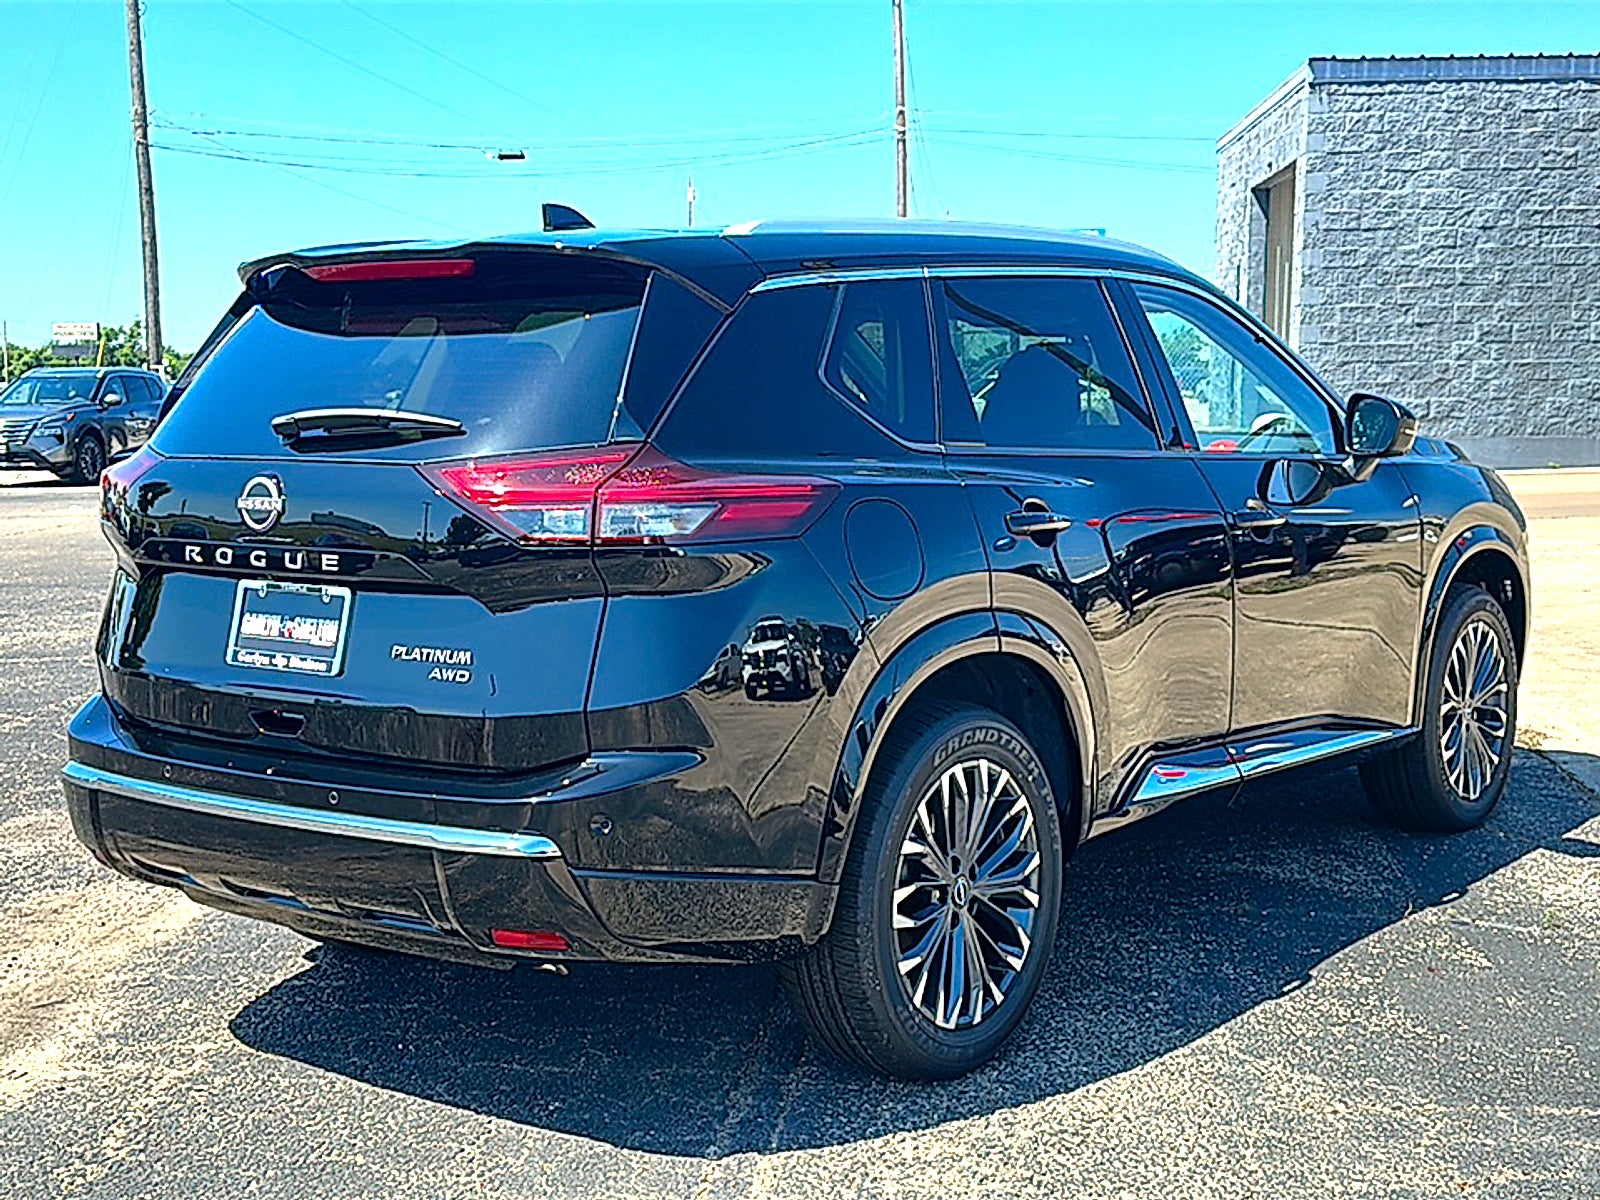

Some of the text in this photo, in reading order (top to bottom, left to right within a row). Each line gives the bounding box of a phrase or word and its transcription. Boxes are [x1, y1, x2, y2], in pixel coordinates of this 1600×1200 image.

[238, 498, 282, 511] NISSAN
[185, 545, 339, 571] ROGUE
[391, 645, 472, 665] PLATINUM
[428, 667, 470, 683] AWD
